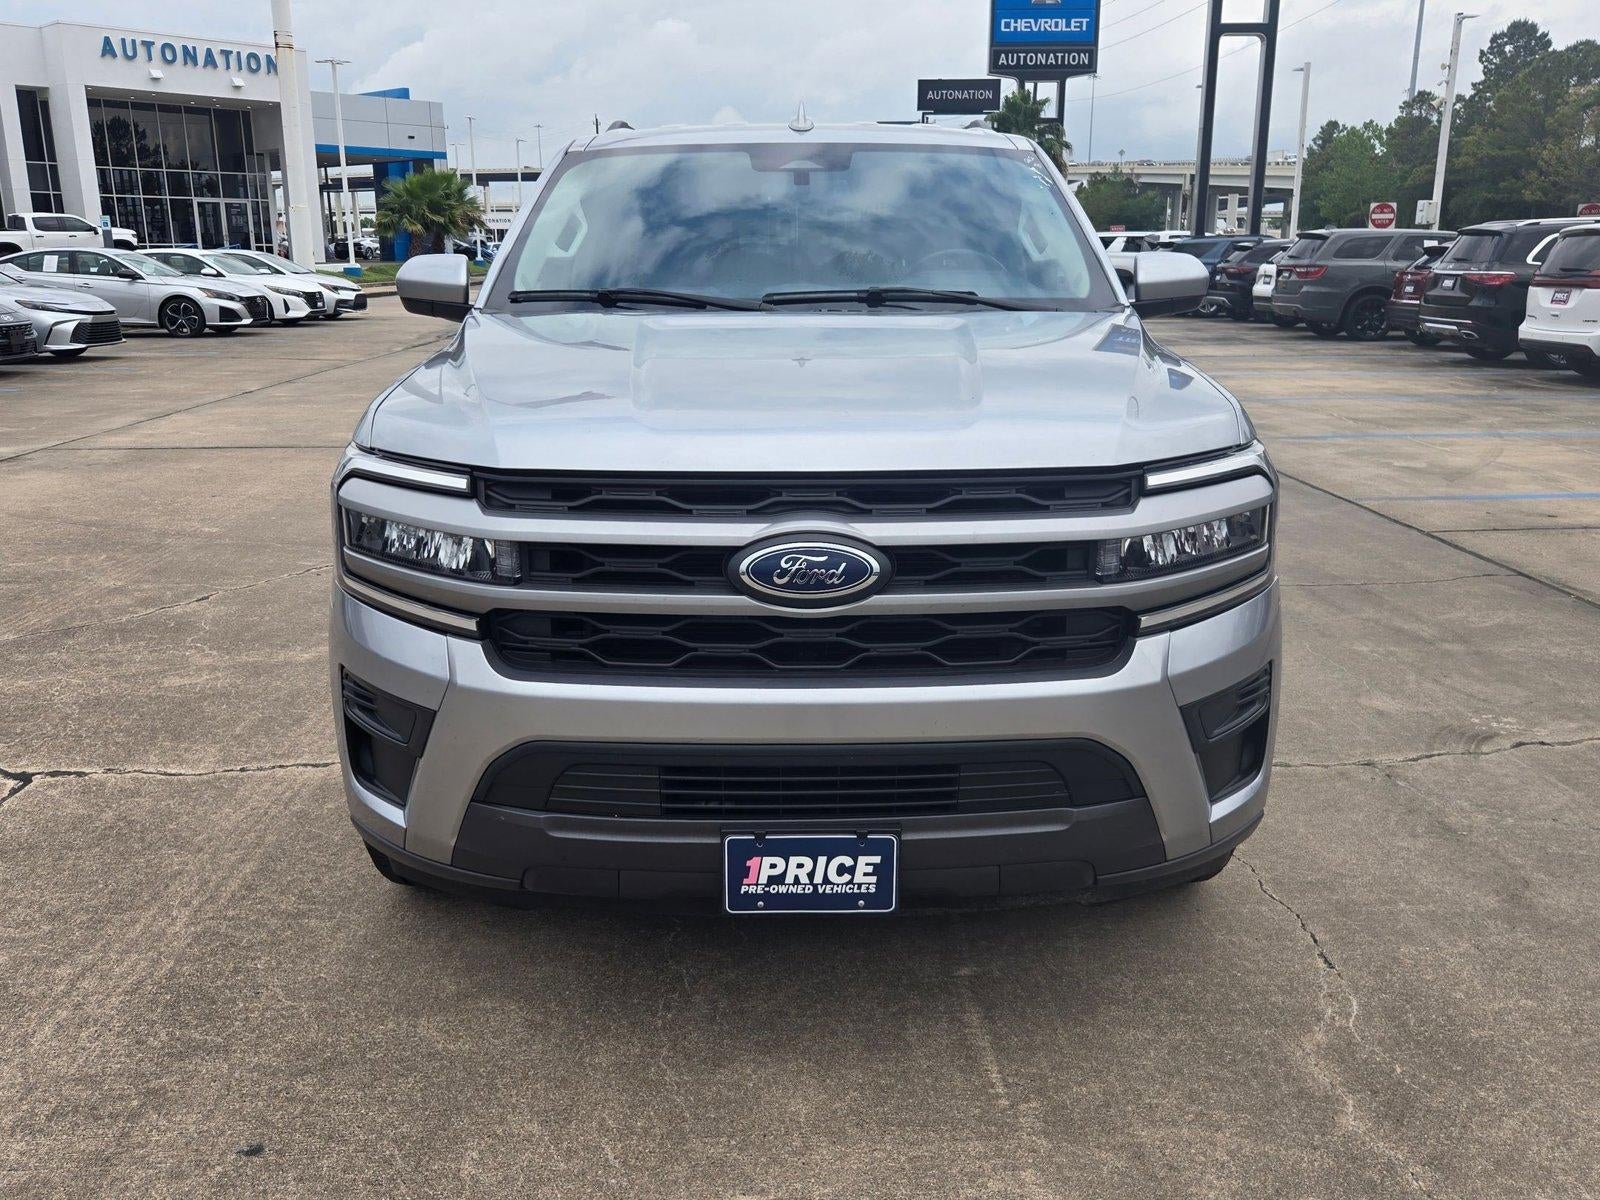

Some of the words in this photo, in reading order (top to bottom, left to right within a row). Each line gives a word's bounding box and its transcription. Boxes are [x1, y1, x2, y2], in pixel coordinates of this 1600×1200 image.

[1001, 18, 1089, 32] CHEVROLET
[101, 35, 278, 75] AUTONATION
[998, 53, 1089, 66] AUTONATION
[926, 90, 993, 100] AUTONATION
[773, 554, 846, 585] Ford
[741, 884, 814, 894] PRE-OWNED
[817, 883, 876, 894] VEHICLES
